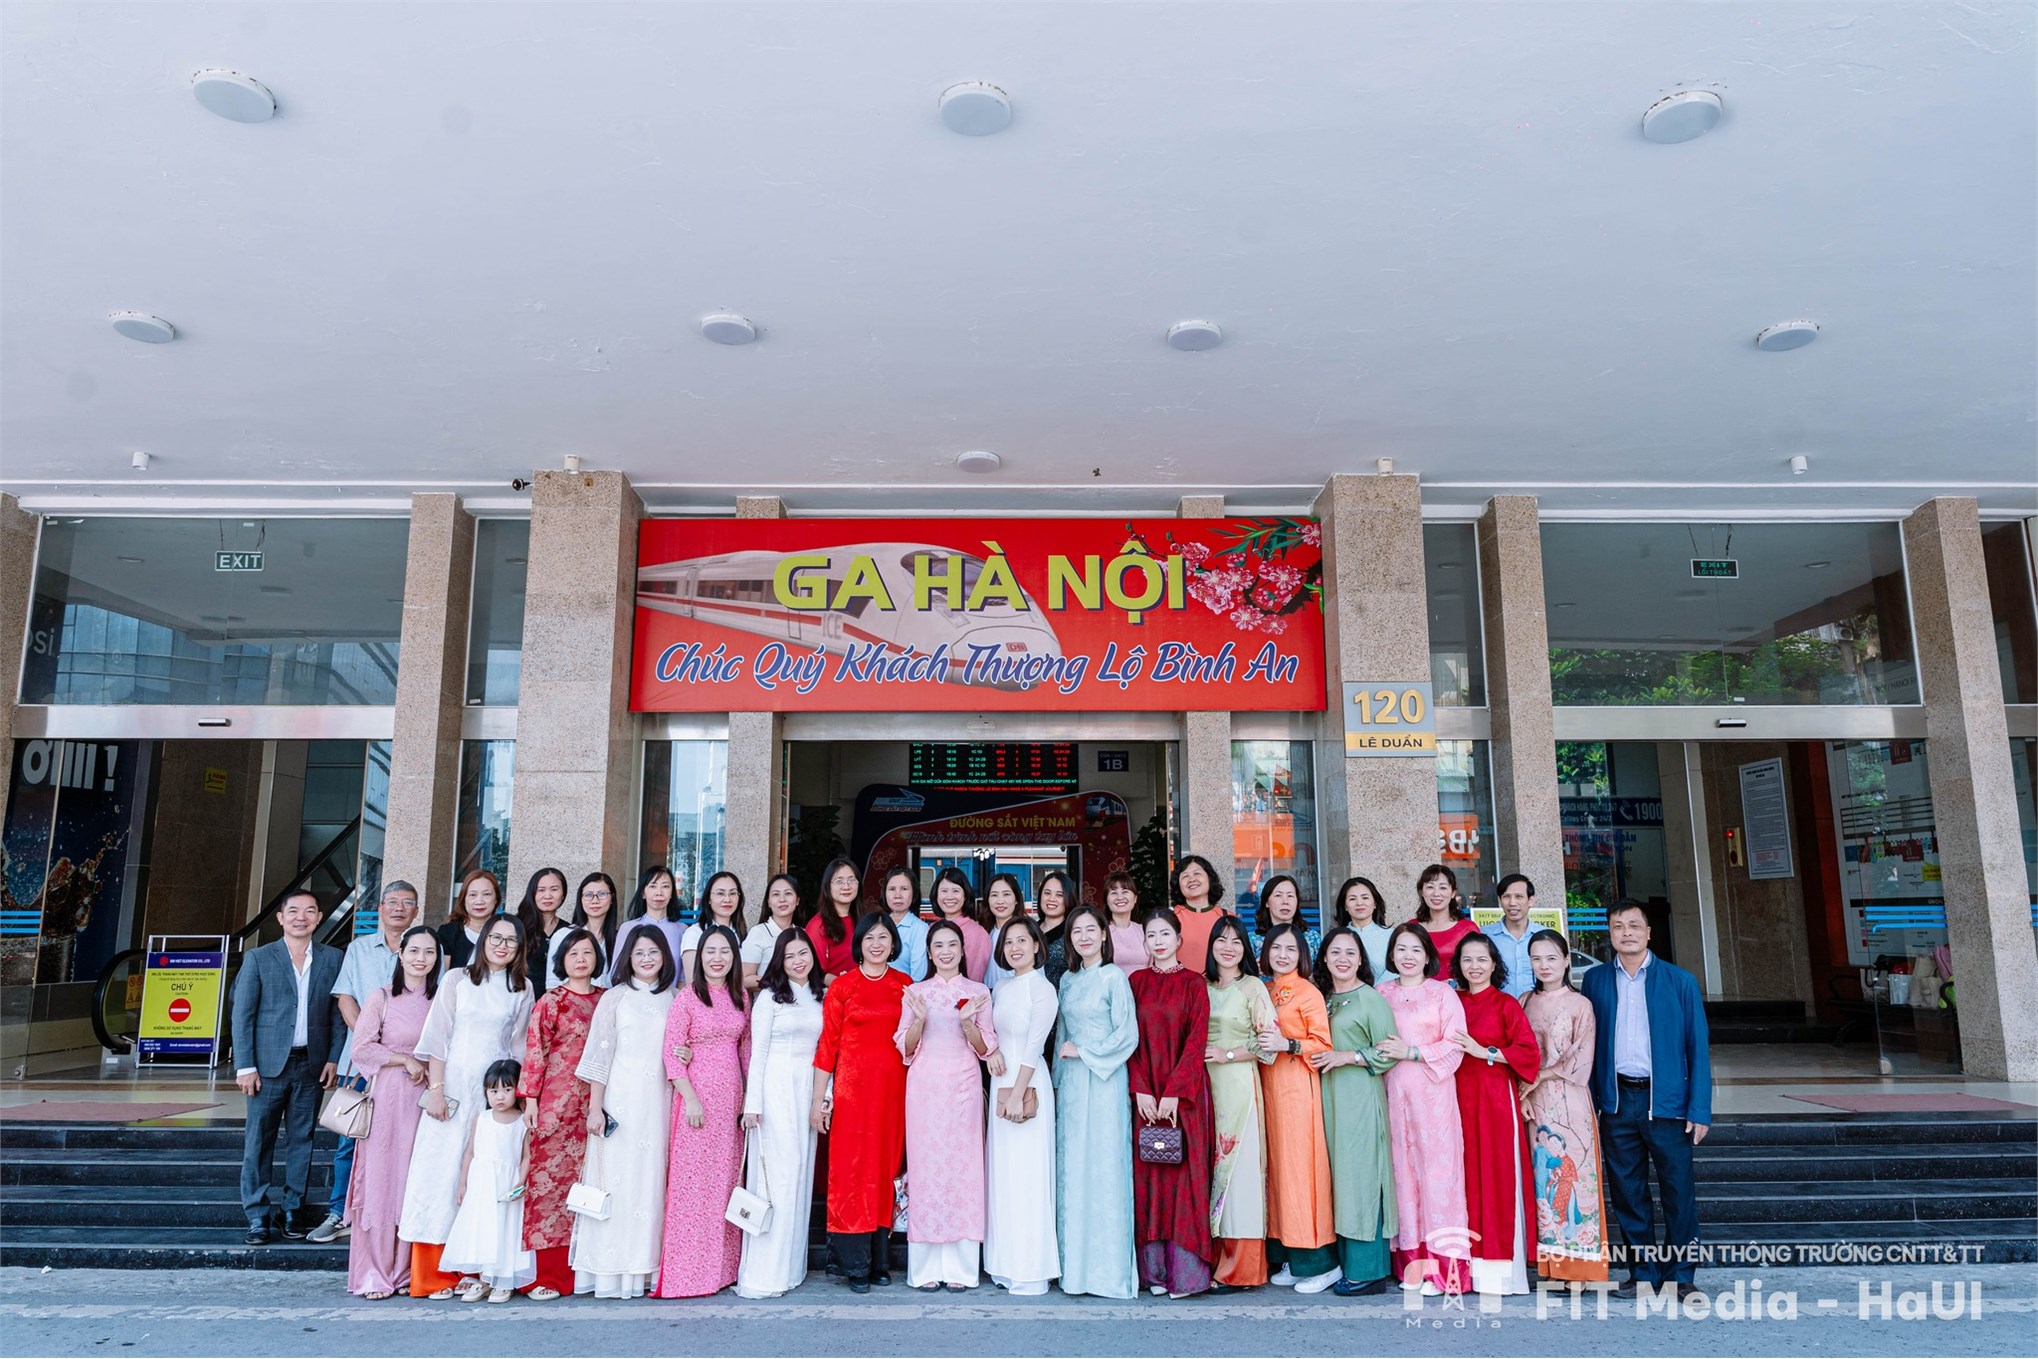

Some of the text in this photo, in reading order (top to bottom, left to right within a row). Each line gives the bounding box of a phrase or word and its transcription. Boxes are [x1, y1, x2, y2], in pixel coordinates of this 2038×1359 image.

[219, 554, 262, 568] EXIT
[773, 540, 1187, 625] GA HÀ NỘI
[822, 611, 842, 640] ICE
[656, 641, 1300, 694] Chúc Quý Khách Thượng Lộ Bình An
[1354, 689, 1425, 724] 120
[1359, 734, 1422, 747] LÊ DUẨN
[1104, 759, 1123, 770] 1B
[949, 813, 1075, 830] ĐƯỜNG SẮT VIỆT NAM
[171, 981, 194, 991] CHÚ Ý
